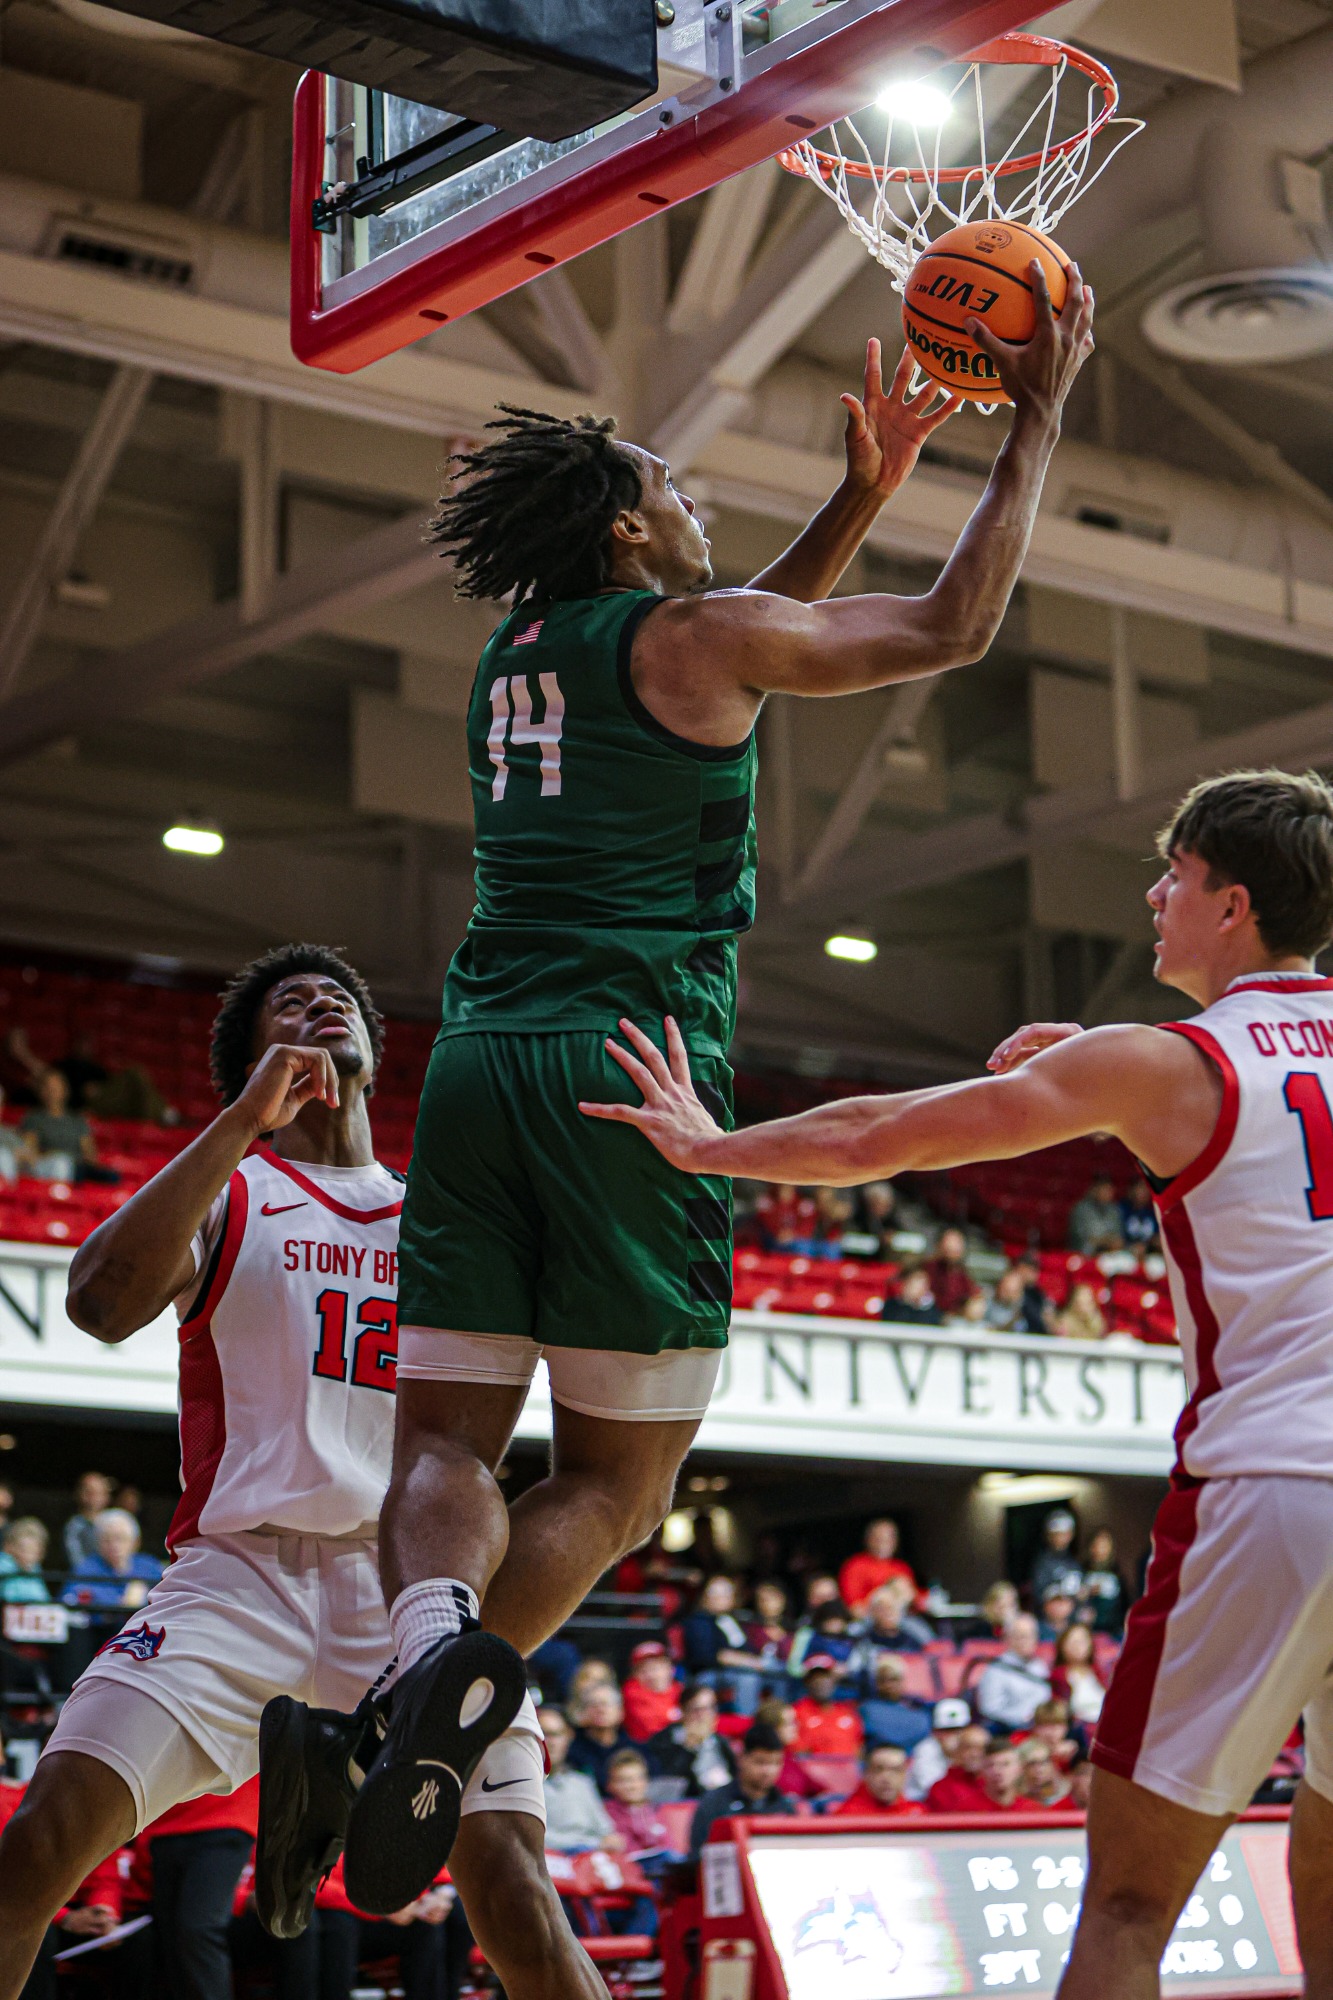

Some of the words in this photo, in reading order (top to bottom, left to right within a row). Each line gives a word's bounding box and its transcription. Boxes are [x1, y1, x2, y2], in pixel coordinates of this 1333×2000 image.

[487, 671, 565, 802] 14
[283, 1239, 367, 1279] STONY
[312, 1288, 398, 1394] 12
[712, 1328, 1185, 1426] NIVERSI
[983, 1903, 1028, 1937] FT
